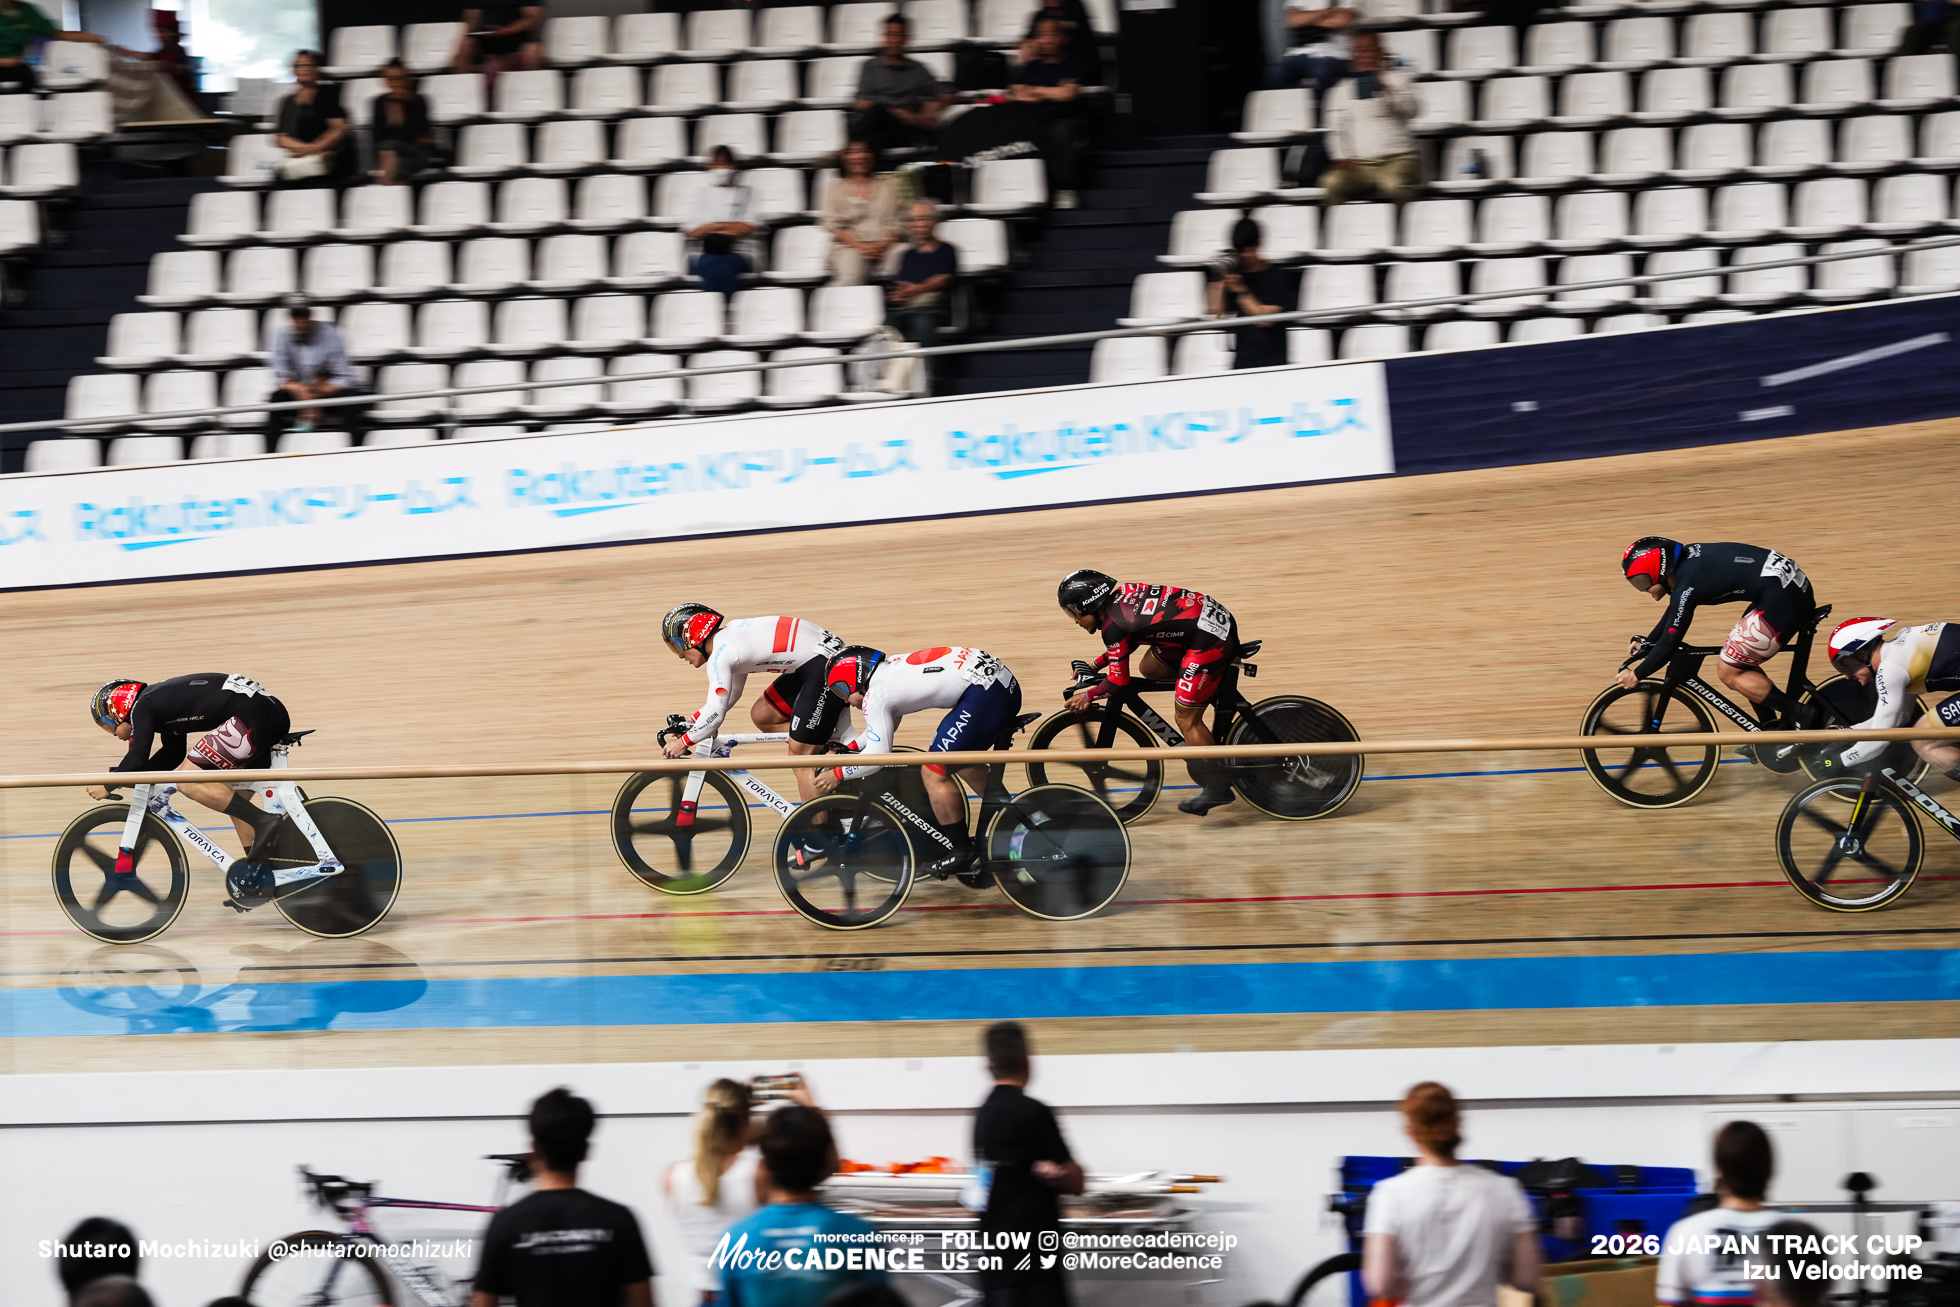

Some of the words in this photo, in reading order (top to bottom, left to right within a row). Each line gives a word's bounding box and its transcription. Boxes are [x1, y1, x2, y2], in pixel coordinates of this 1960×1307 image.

[1082, 586, 1110, 606] Kabuto
[700, 615, 717, 639] JAPAN
[1206, 603, 1227, 626] 70
[822, 632, 844, 652] 72
[1183, 661, 1200, 681] CIMB
[122, 684, 138, 710] JAPAN
[1686, 678, 1762, 732] BRIDGESTONE
[937, 709, 972, 752] JAPAN
[745, 778, 788, 813] TORAYCA
[1881, 767, 1960, 829] LOOK
[880, 791, 954, 851] BRIDGESTONE
[183, 826, 225, 863] TORAYCA
